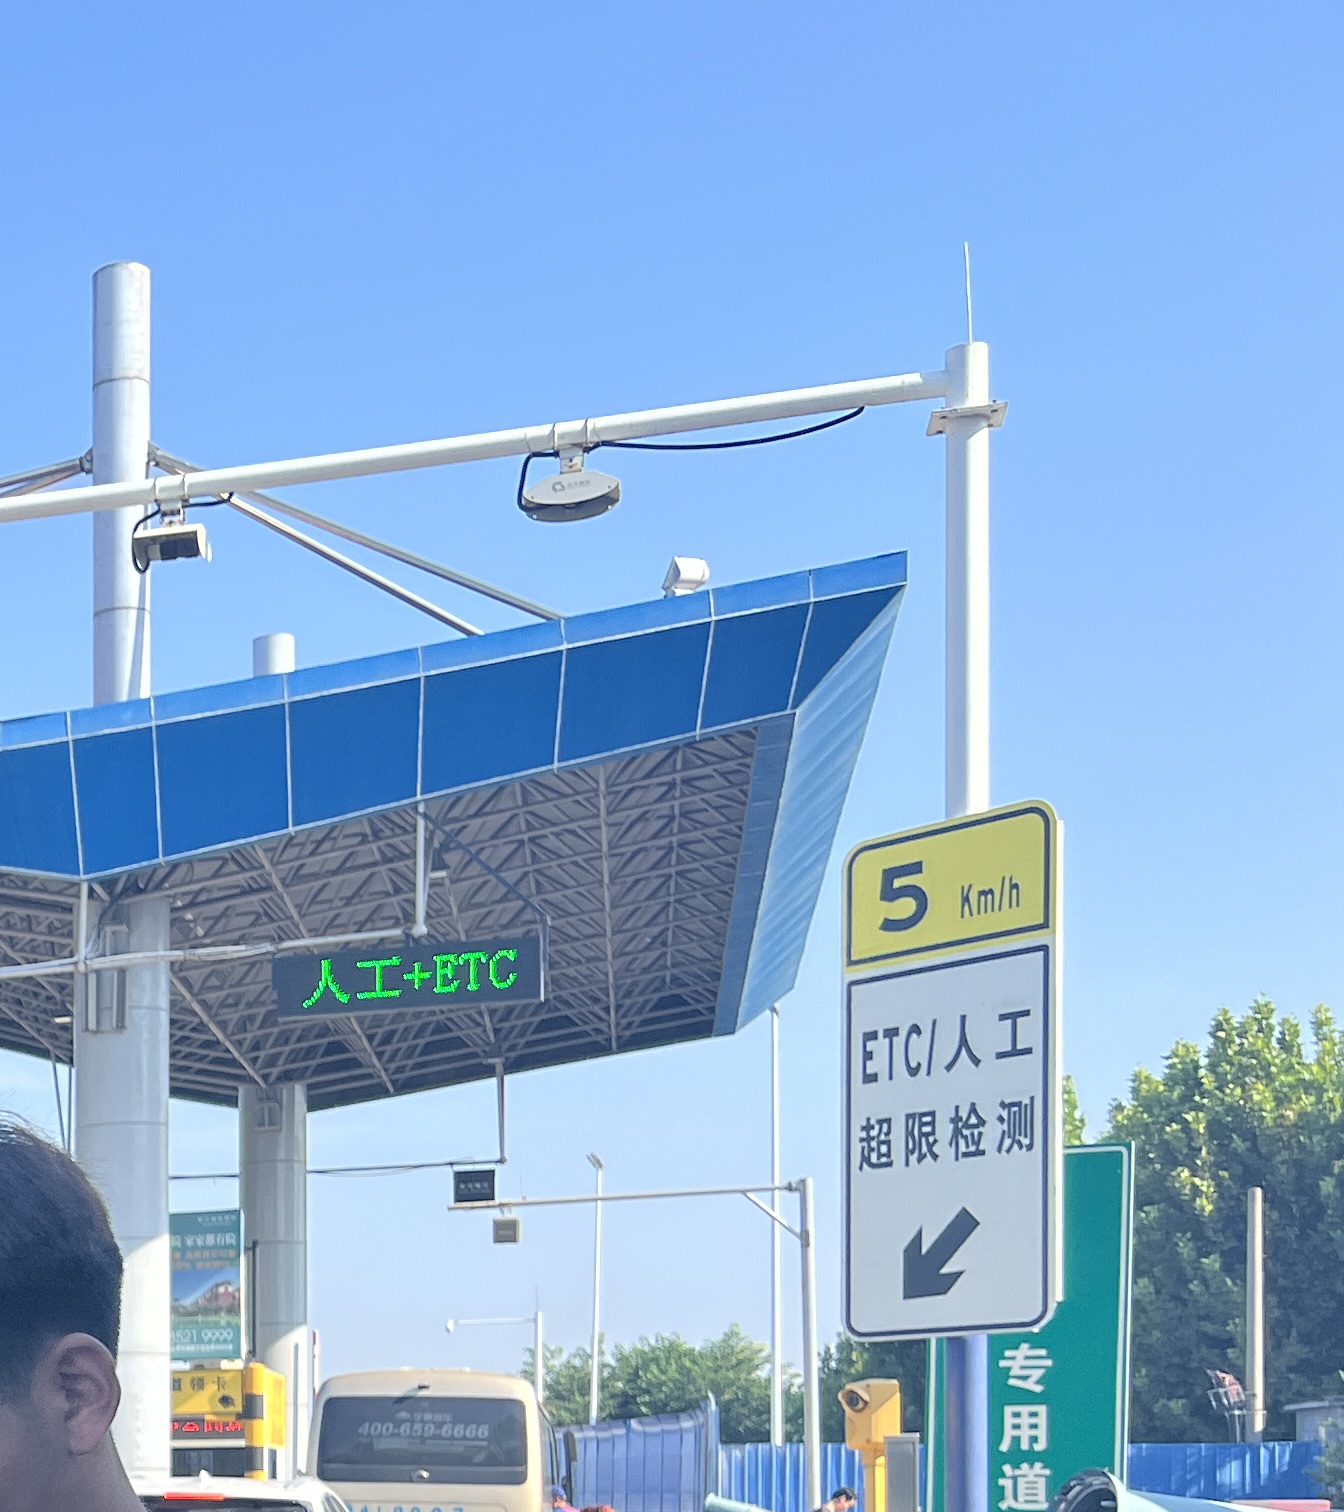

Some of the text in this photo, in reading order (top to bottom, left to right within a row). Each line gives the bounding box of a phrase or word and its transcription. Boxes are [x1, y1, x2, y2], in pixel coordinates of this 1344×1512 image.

[879, 860, 1021, 932] 5 Km/h
[302, 949, 518, 1009] 人工+ETC
[861, 1008, 1034, 1085] ETC/人工
[858, 1096, 1036, 1173] 超限检测
[998, 1342, 1053, 1512] 专用道
